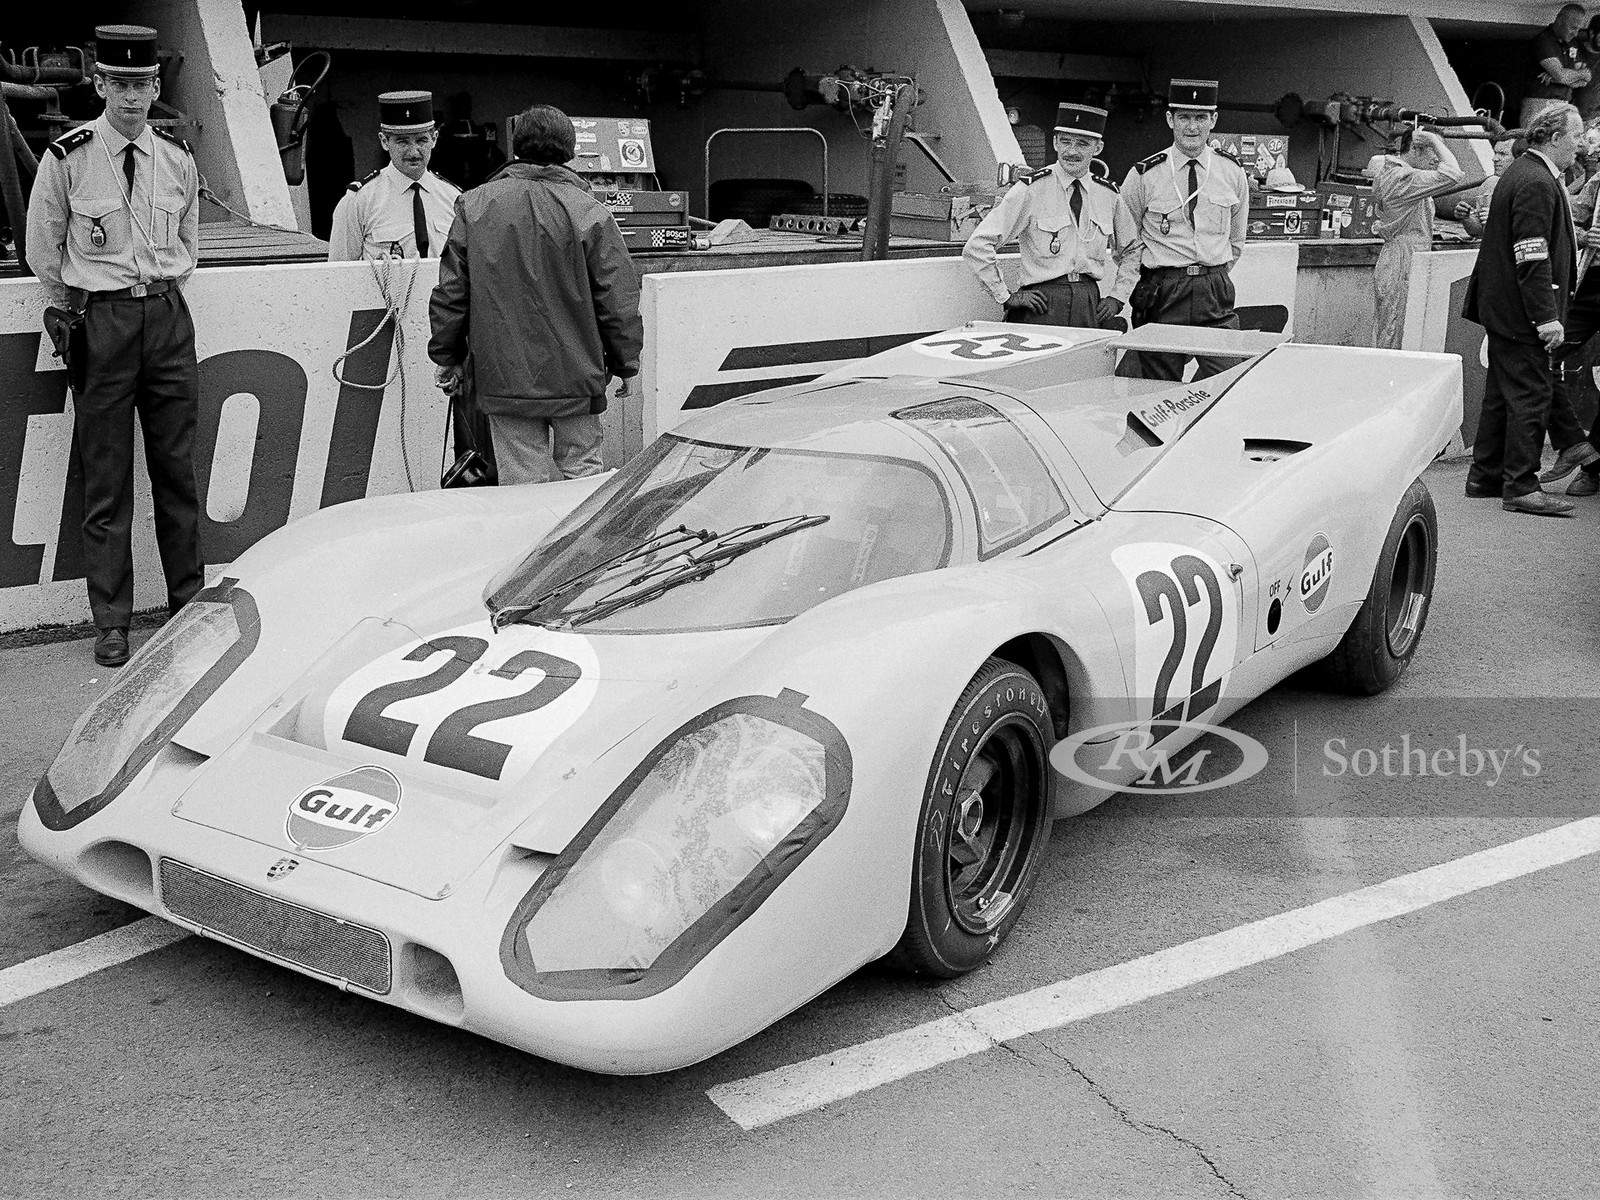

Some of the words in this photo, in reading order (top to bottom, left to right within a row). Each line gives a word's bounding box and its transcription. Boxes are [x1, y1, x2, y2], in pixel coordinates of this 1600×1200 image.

[665, 230, 688, 238] BOSCH
[1140, 389, 1211, 428] Gulf-Porsche
[1269, 579, 1281, 597] OFF
[1300, 551, 1333, 596] Gulf
[1136, 554, 1223, 750] 22
[342, 635, 582, 781] 22
[298, 789, 392, 829] Gulf
